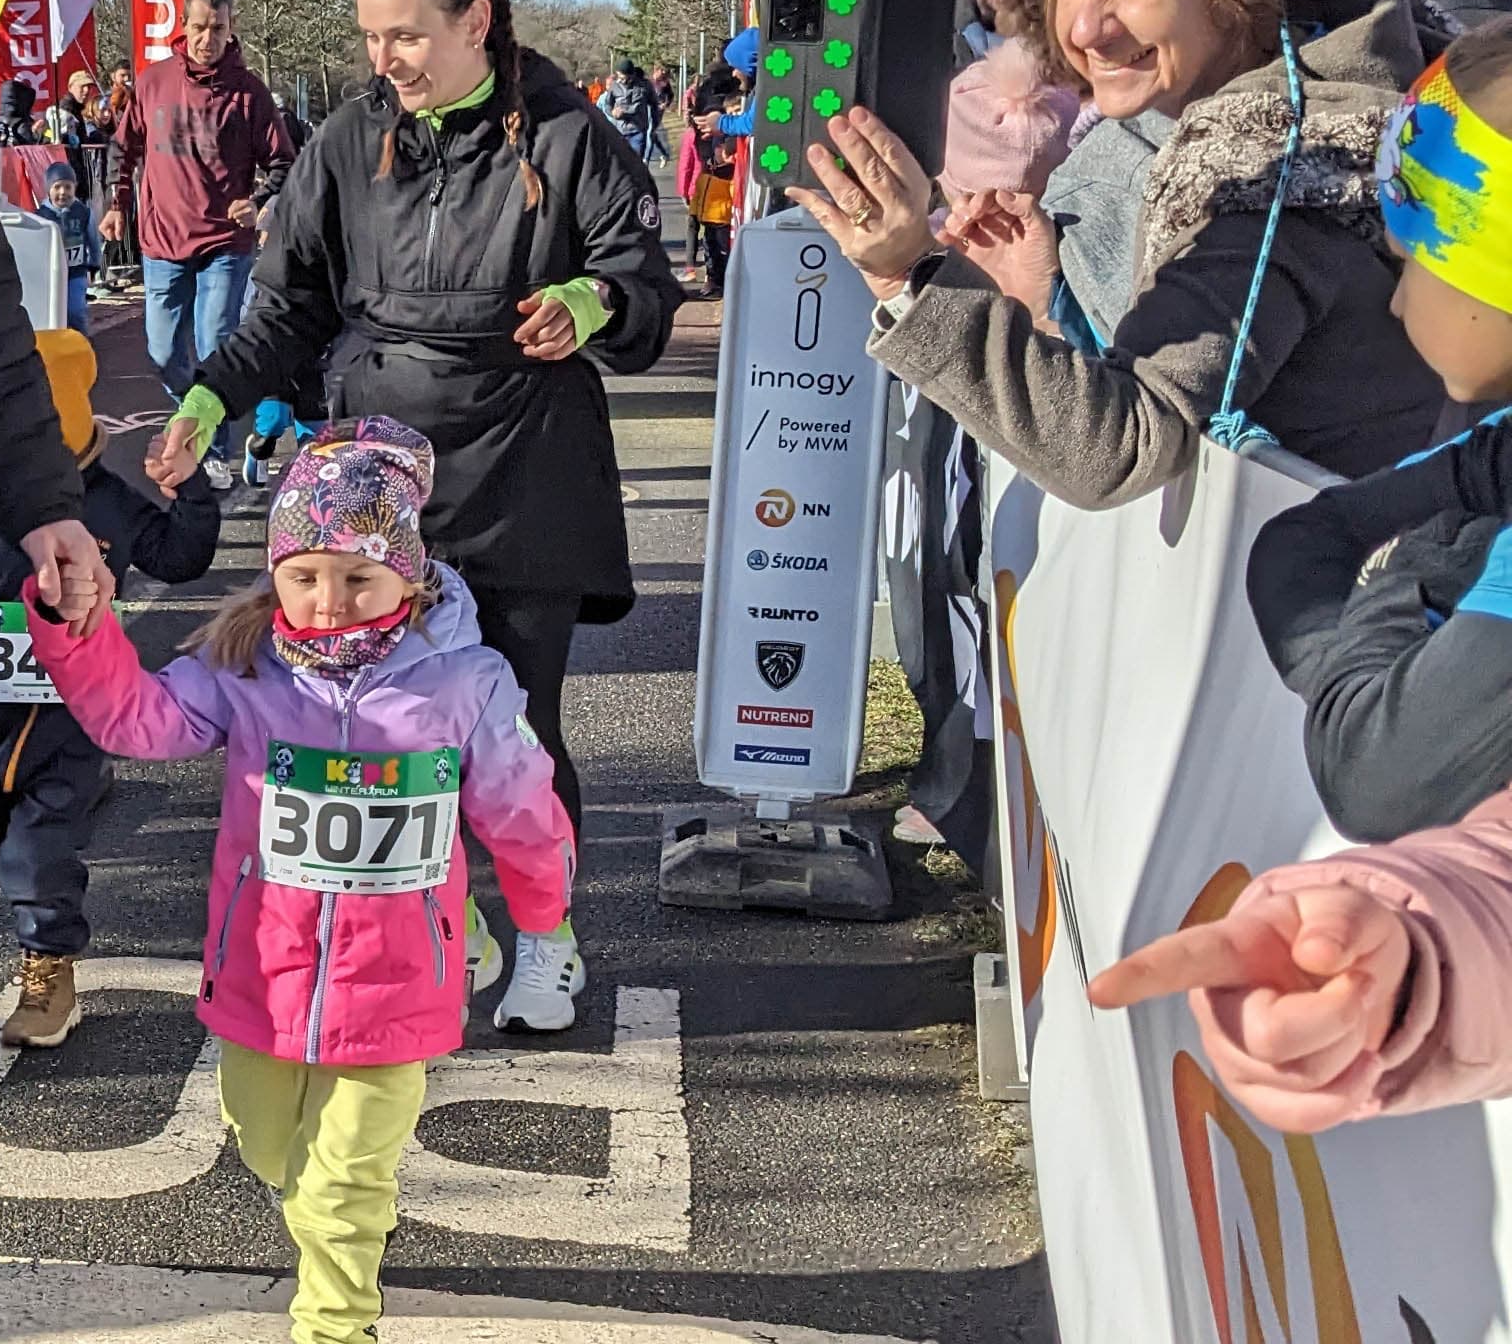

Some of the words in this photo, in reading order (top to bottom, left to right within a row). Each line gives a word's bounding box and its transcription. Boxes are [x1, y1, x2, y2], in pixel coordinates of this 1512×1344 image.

[751, 364, 855, 396] innogy
[779, 417, 851, 434] Powered
[778, 435, 798, 452] by
[804, 437, 848, 452] MVM
[802, 503, 830, 517] NN
[770, 553, 828, 571] ŠKODA
[761, 608, 819, 622] RUNTO
[741, 709, 809, 724] NUTREND
[271, 794, 438, 864] 3071
